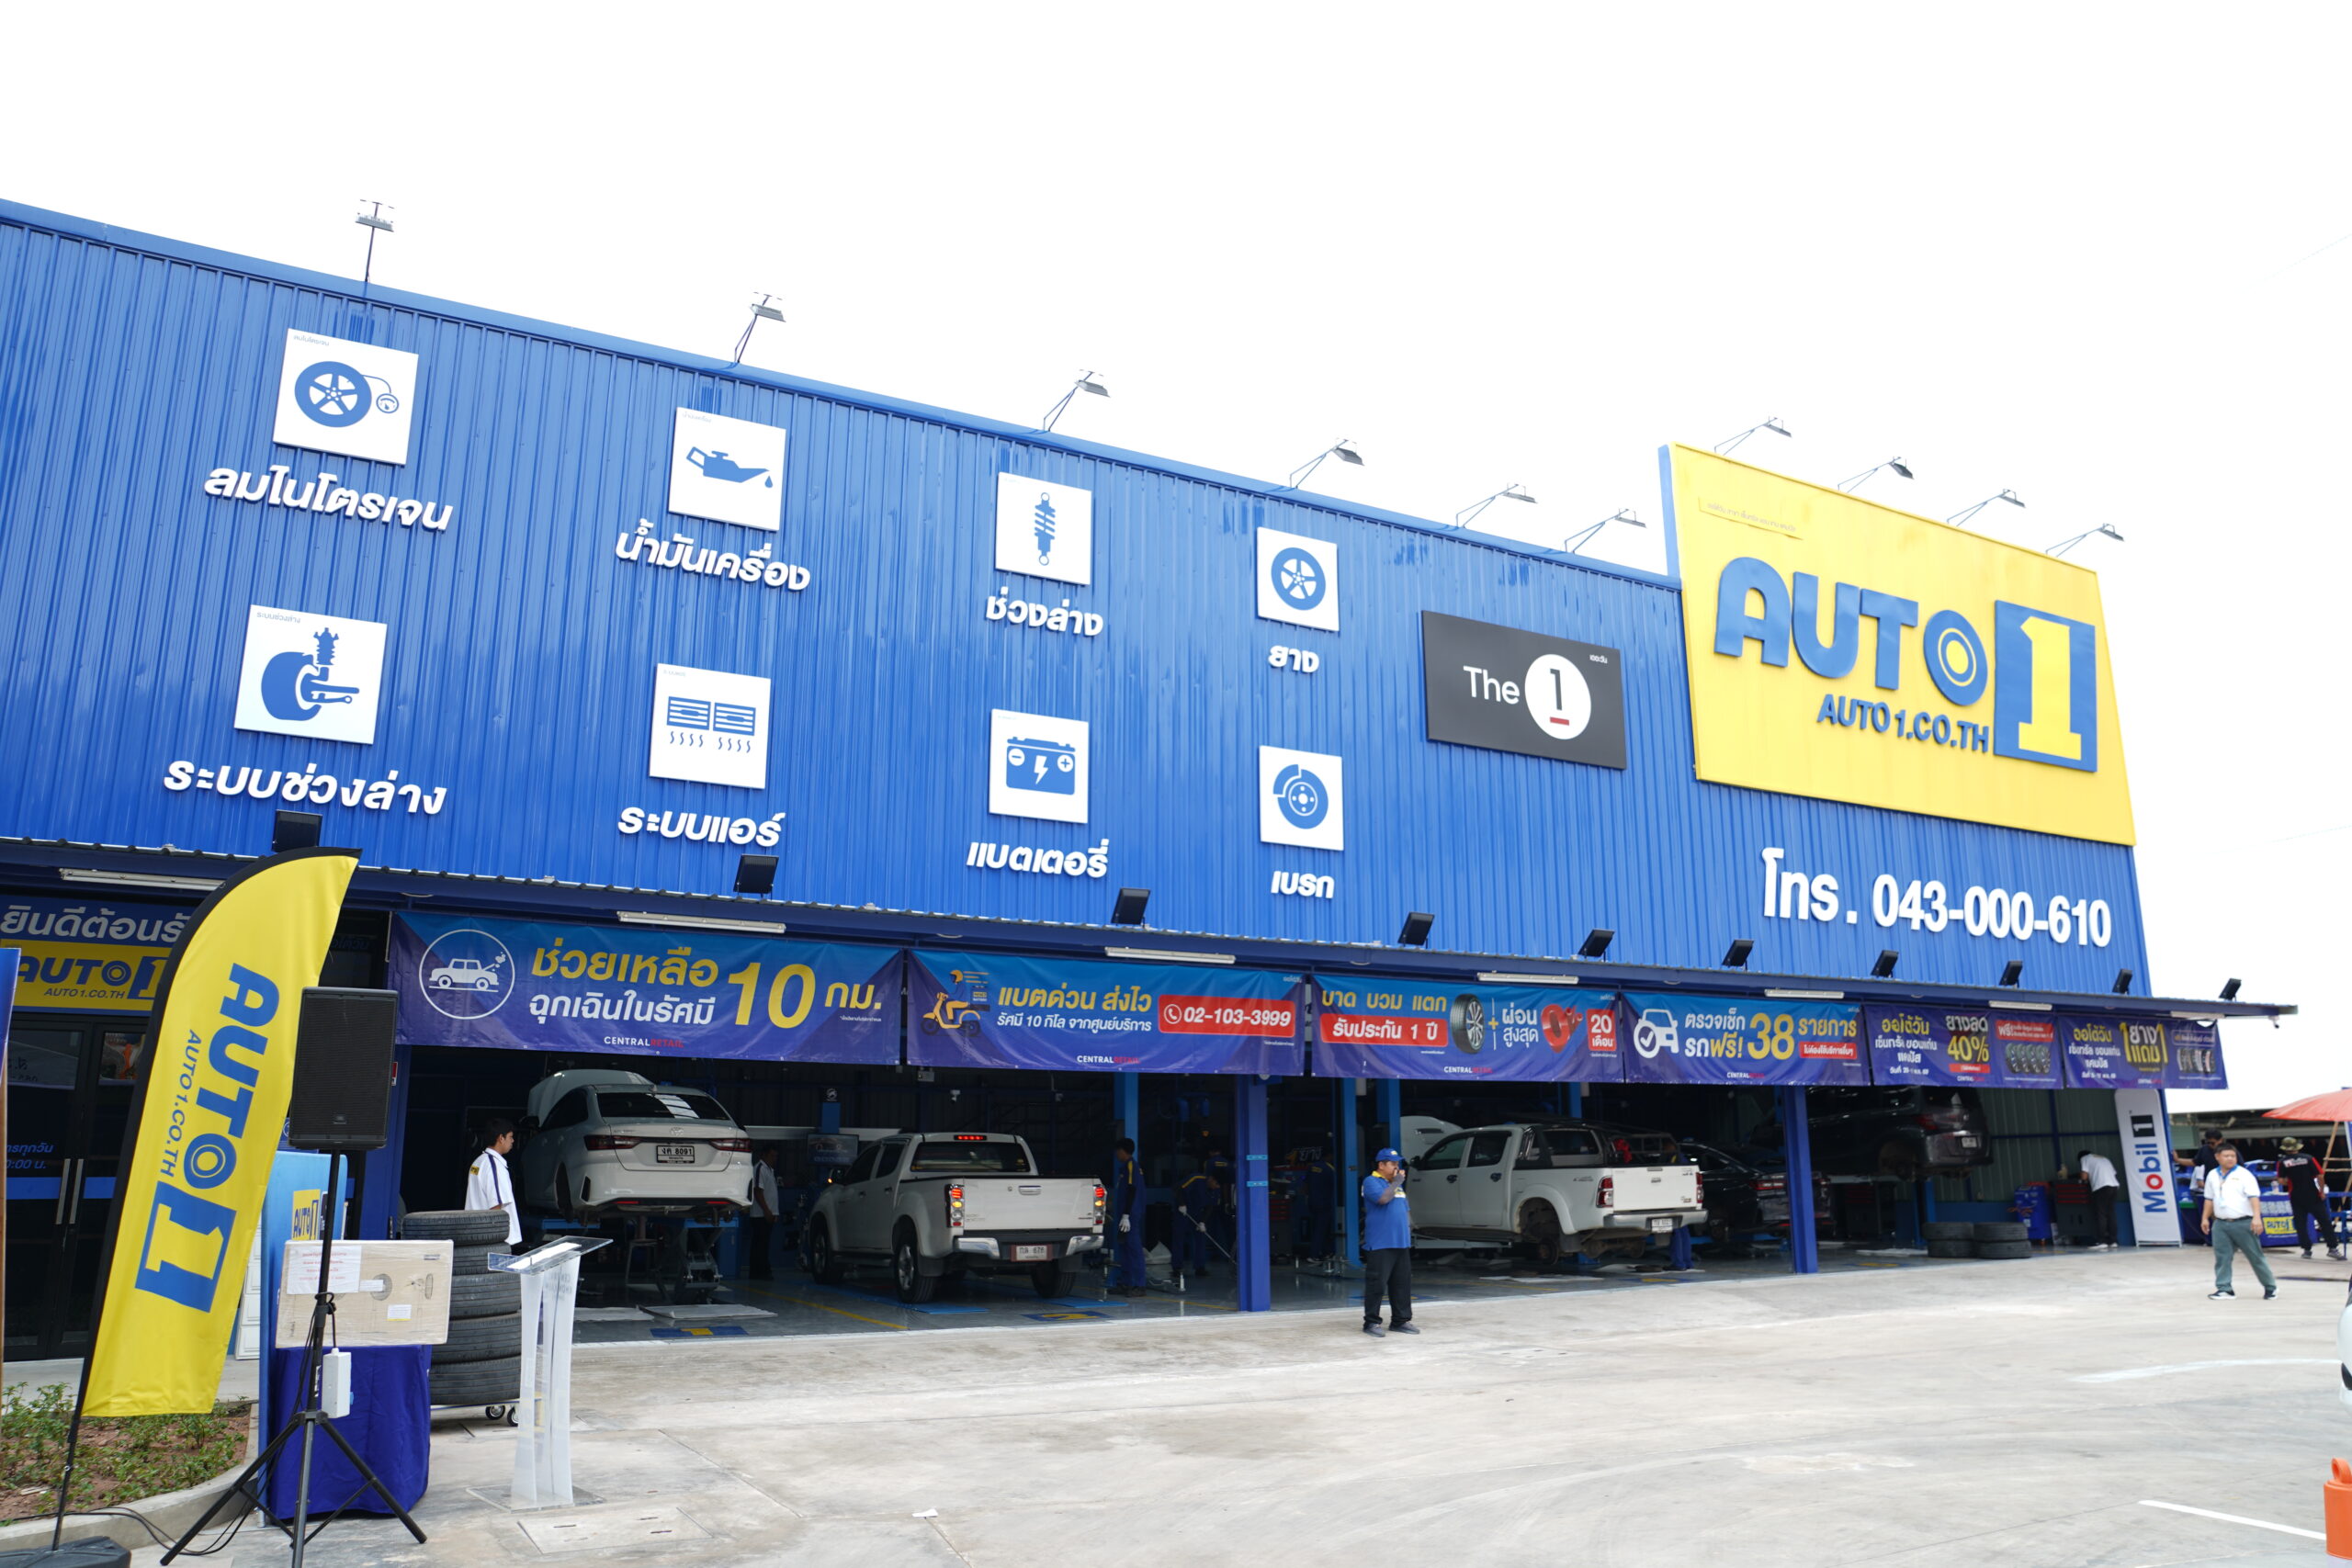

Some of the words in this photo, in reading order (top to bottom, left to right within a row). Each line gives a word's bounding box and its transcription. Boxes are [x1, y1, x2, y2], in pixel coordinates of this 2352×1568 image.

[204, 466, 453, 531] ลมไนโตรเจน
[616, 518, 810, 592] น้ำมันเครื่อง
[986, 586, 1103, 637] ช่วงล่าง
[1268, 645, 1320, 673] ยาง
[1463, 665, 1521, 705] The
[163, 760, 447, 815] ระบบช่วงล่าง
[616, 807, 786, 848] ระบบแอร์
[967, 839, 1110, 879] แบตเตอรี่
[1271, 871, 1335, 899] เบรก
[0, 905, 192, 942] ยินดีต้อนรั
[1872, 874, 2112, 948] 043-000-610
[531, 937, 719, 987] ช่วยเหลือ
[529, 989, 717, 1025] ฉุกเฉินในรัศมี
[727, 962, 816, 1029] 10
[825, 980, 882, 1010] กม.
[998, 982, 1097, 1010] แบตด่วน
[1102, 985, 1153, 1012] ส่งไว
[1321, 990, 1357, 1008] บาด
[1366, 993, 1403, 1010] บวม
[1412, 995, 1447, 1011] แตก
[997, 1012, 1024, 1027] รัศมี
[1026, 1014, 1042, 1028] 10
[1044, 1013, 1066, 1028] กิโล
[1069, 1016, 1152, 1034] จากศูนย์บริการ
[1183, 1007, 1292, 1027] 02-103-3999
[1332, 1018, 1403, 1039] รับประกัน
[1410, 1023, 1419, 1040] 1
[1426, 1021, 1438, 1040] ปี
[1501, 1002, 1537, 1025] ผ่อน
[1590, 1014, 1612, 1033] 20
[1946, 1015, 1988, 1032] ยางลด
[1503, 1027, 1539, 1048] สูงสุด
[1592, 1035, 1613, 1047] เดือน
[1747, 1012, 1794, 1060] 38
[1798, 1018, 1857, 1037] รายการ
[1948, 1035, 1989, 1062] 40%
[2129, 1025, 2157, 1044] ยาง
[2134, 1143, 2168, 1213] Mobil
